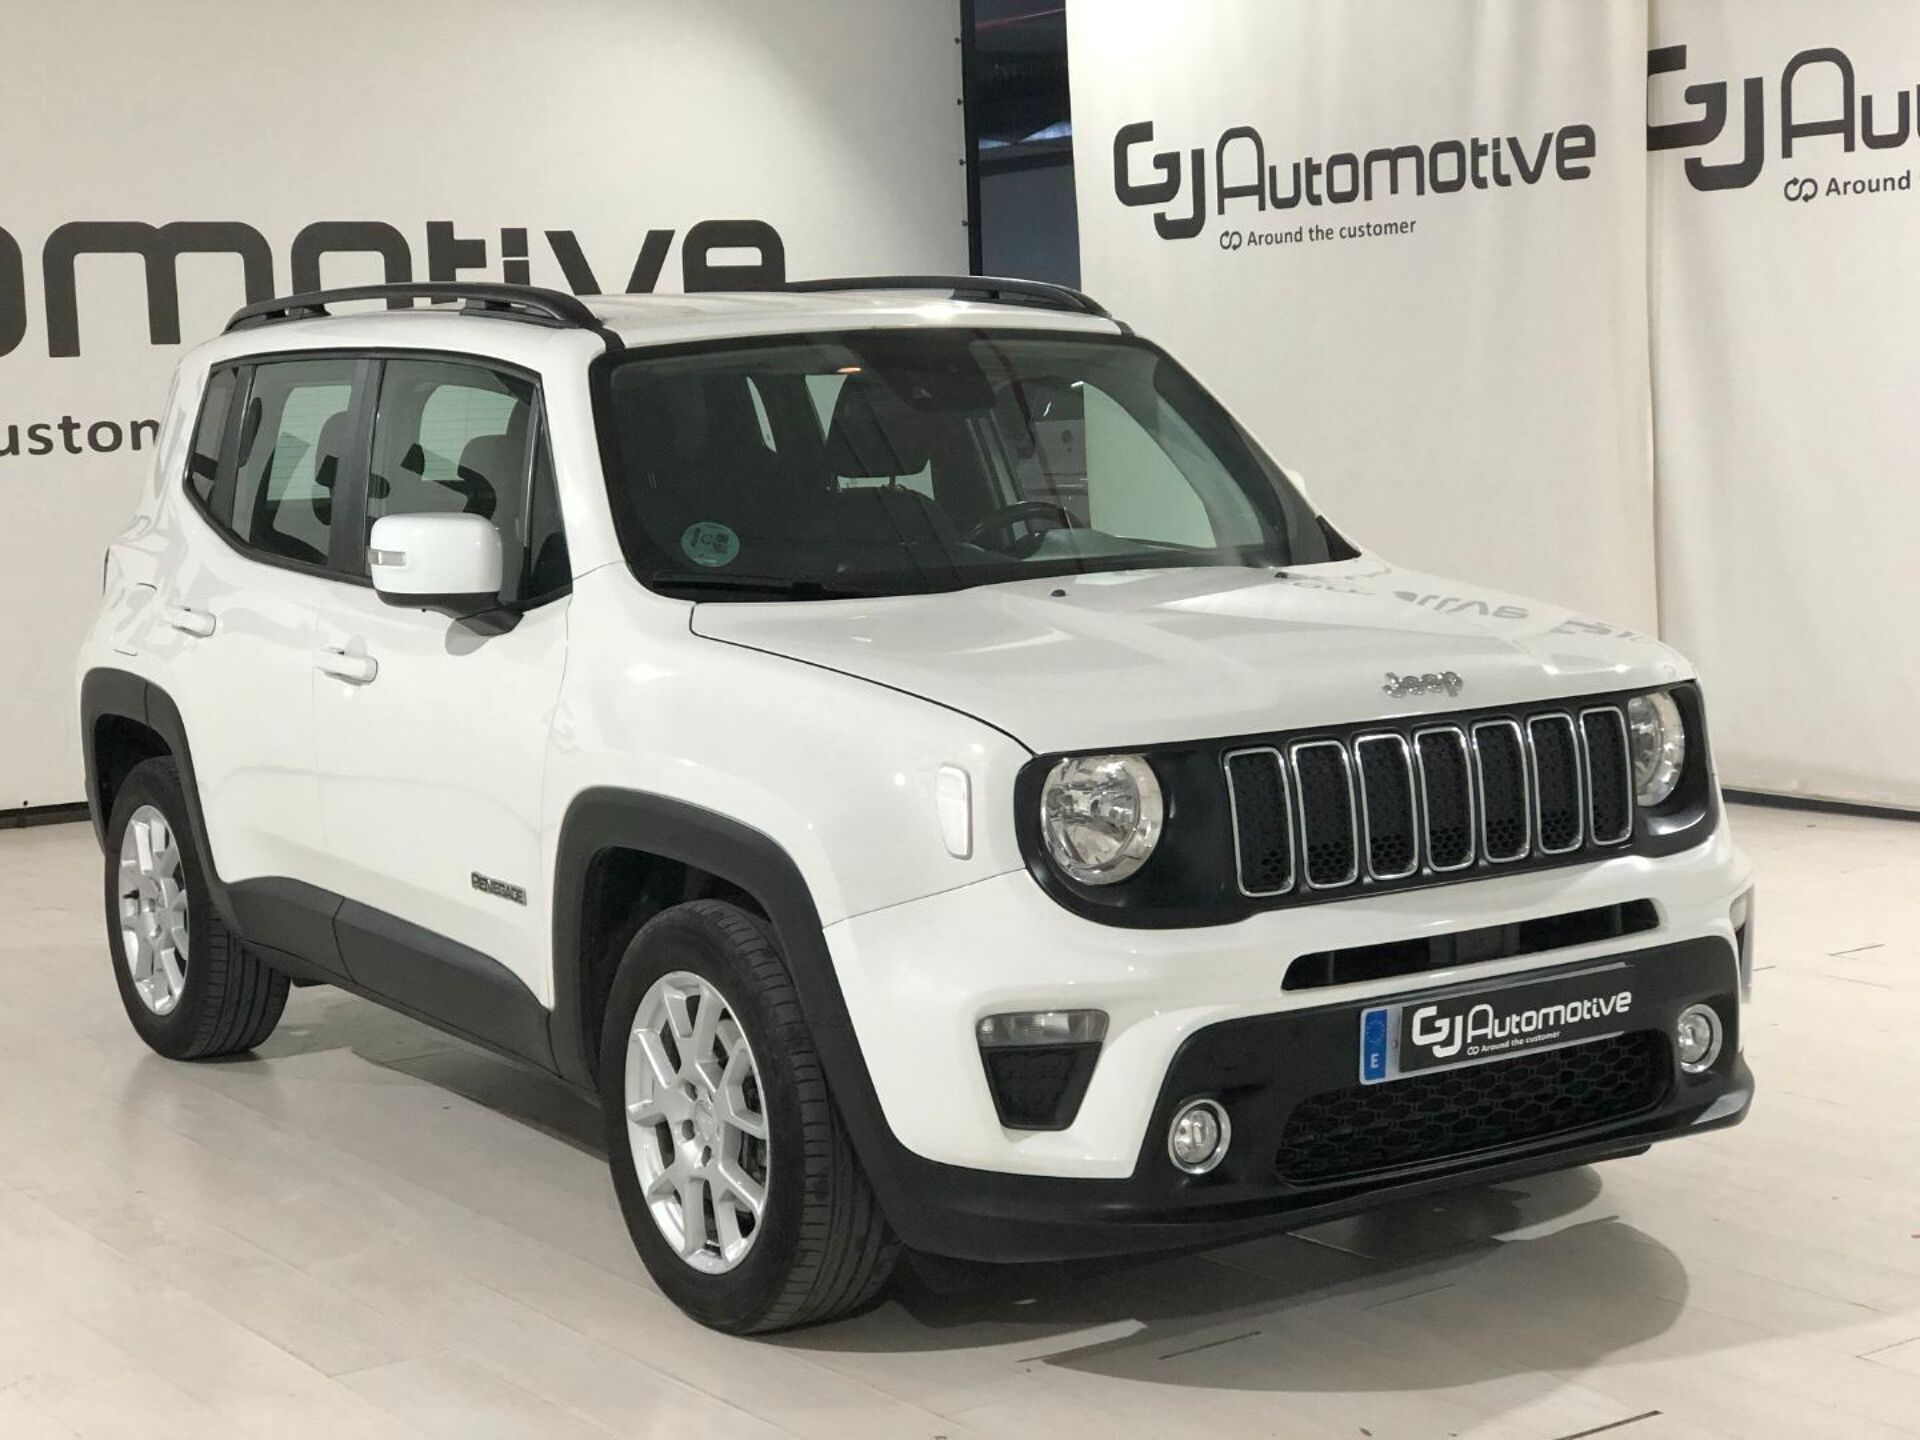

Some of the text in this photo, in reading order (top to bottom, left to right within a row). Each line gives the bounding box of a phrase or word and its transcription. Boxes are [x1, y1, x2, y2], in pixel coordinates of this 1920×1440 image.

[1649, 44, 1920, 191] GJ Au
[1113, 120, 1596, 241] GJ Automotive
[1826, 170, 1911, 198] Around
[1247, 219, 1417, 247] Around the customer
[0, 220, 785, 357] motive
[1382, 671, 1463, 699] Jeep
[1411, 991, 1632, 1058] GJ Automotive
[1480, 1030, 1562, 1054] Around the customer
[1370, 1053, 1379, 1069] E
